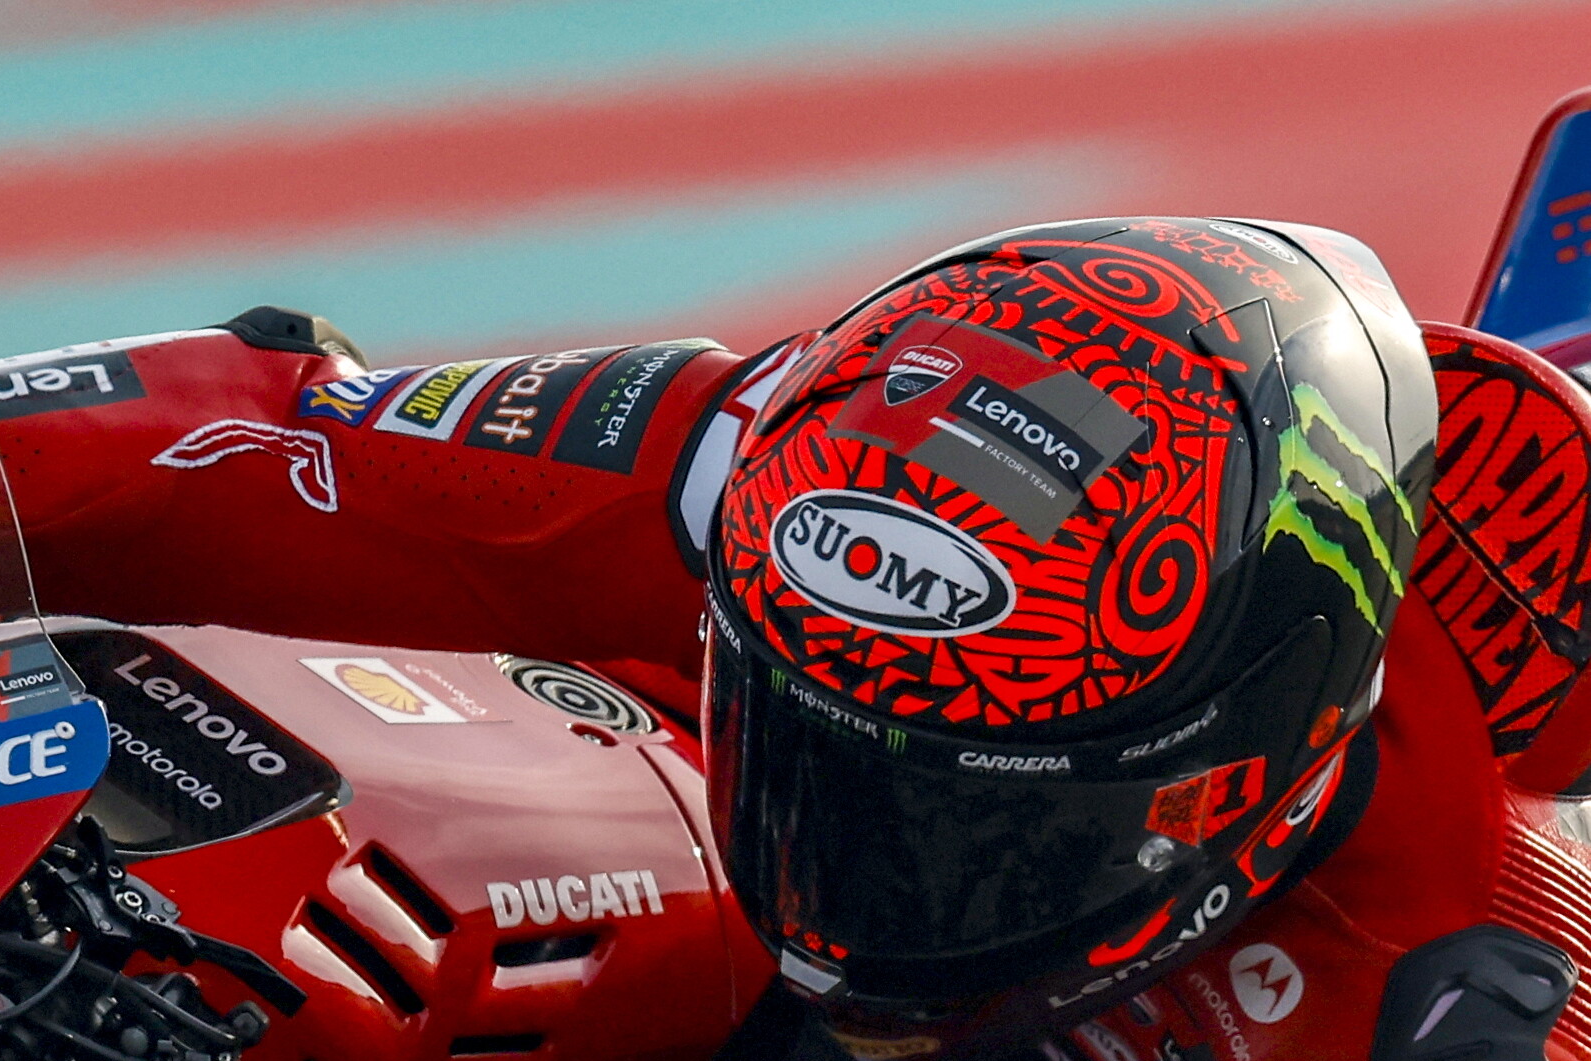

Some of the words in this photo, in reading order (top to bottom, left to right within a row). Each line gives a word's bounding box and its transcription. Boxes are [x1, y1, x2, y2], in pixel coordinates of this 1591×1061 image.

[901, 350, 956, 373] DUCATI
[965, 385, 1081, 472] Lenovo
[983, 444, 1029, 476] FACTORY
[1028, 472, 1058, 500] TEAM
[789, 501, 986, 629] SUOMY
[0, 671, 54, 692] Lenovo
[112, 653, 287, 776] Lenovo
[107, 722, 223, 811] motorola
[958, 750, 1071, 772] CARRERA
[485, 869, 665, 929] DUCATI
[1048, 883, 1231, 1009] Lenovo
